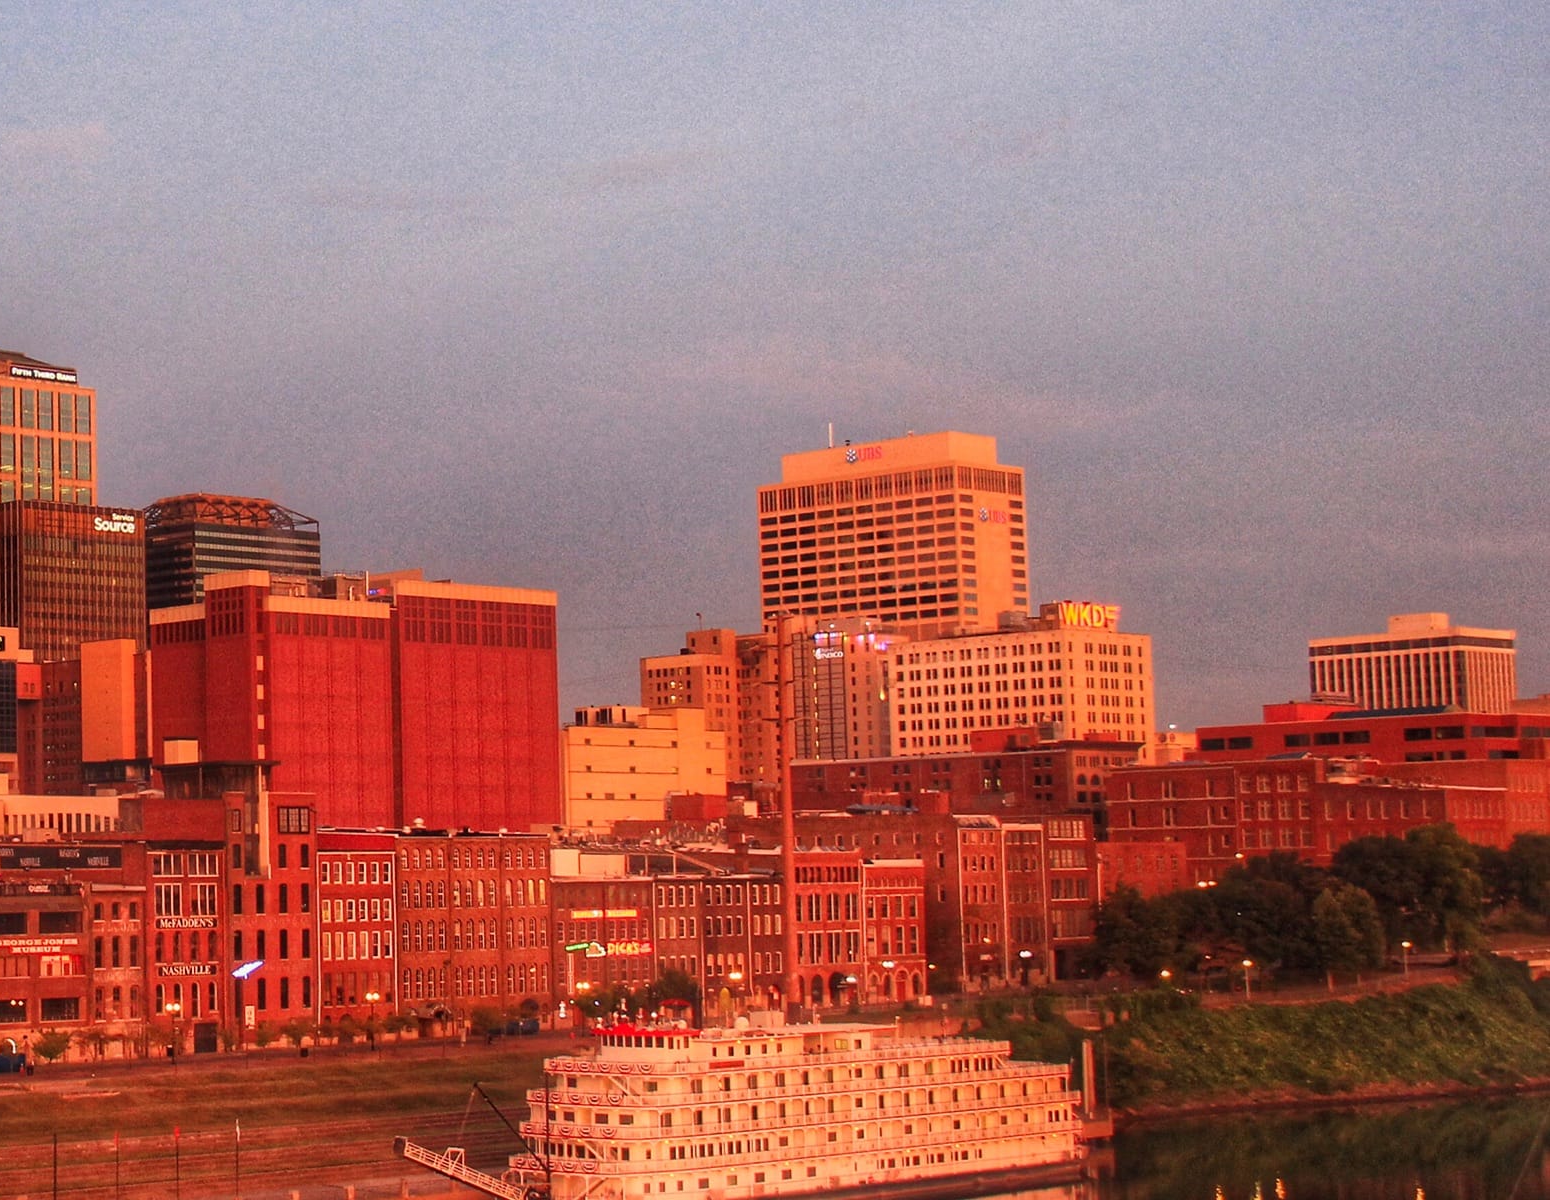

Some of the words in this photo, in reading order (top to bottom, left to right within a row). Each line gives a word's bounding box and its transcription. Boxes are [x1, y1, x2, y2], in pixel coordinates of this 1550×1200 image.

[94, 517, 135, 534] Source
[43, 938, 78, 946] JONES
[161, 965, 211, 976] NASHVILLE
